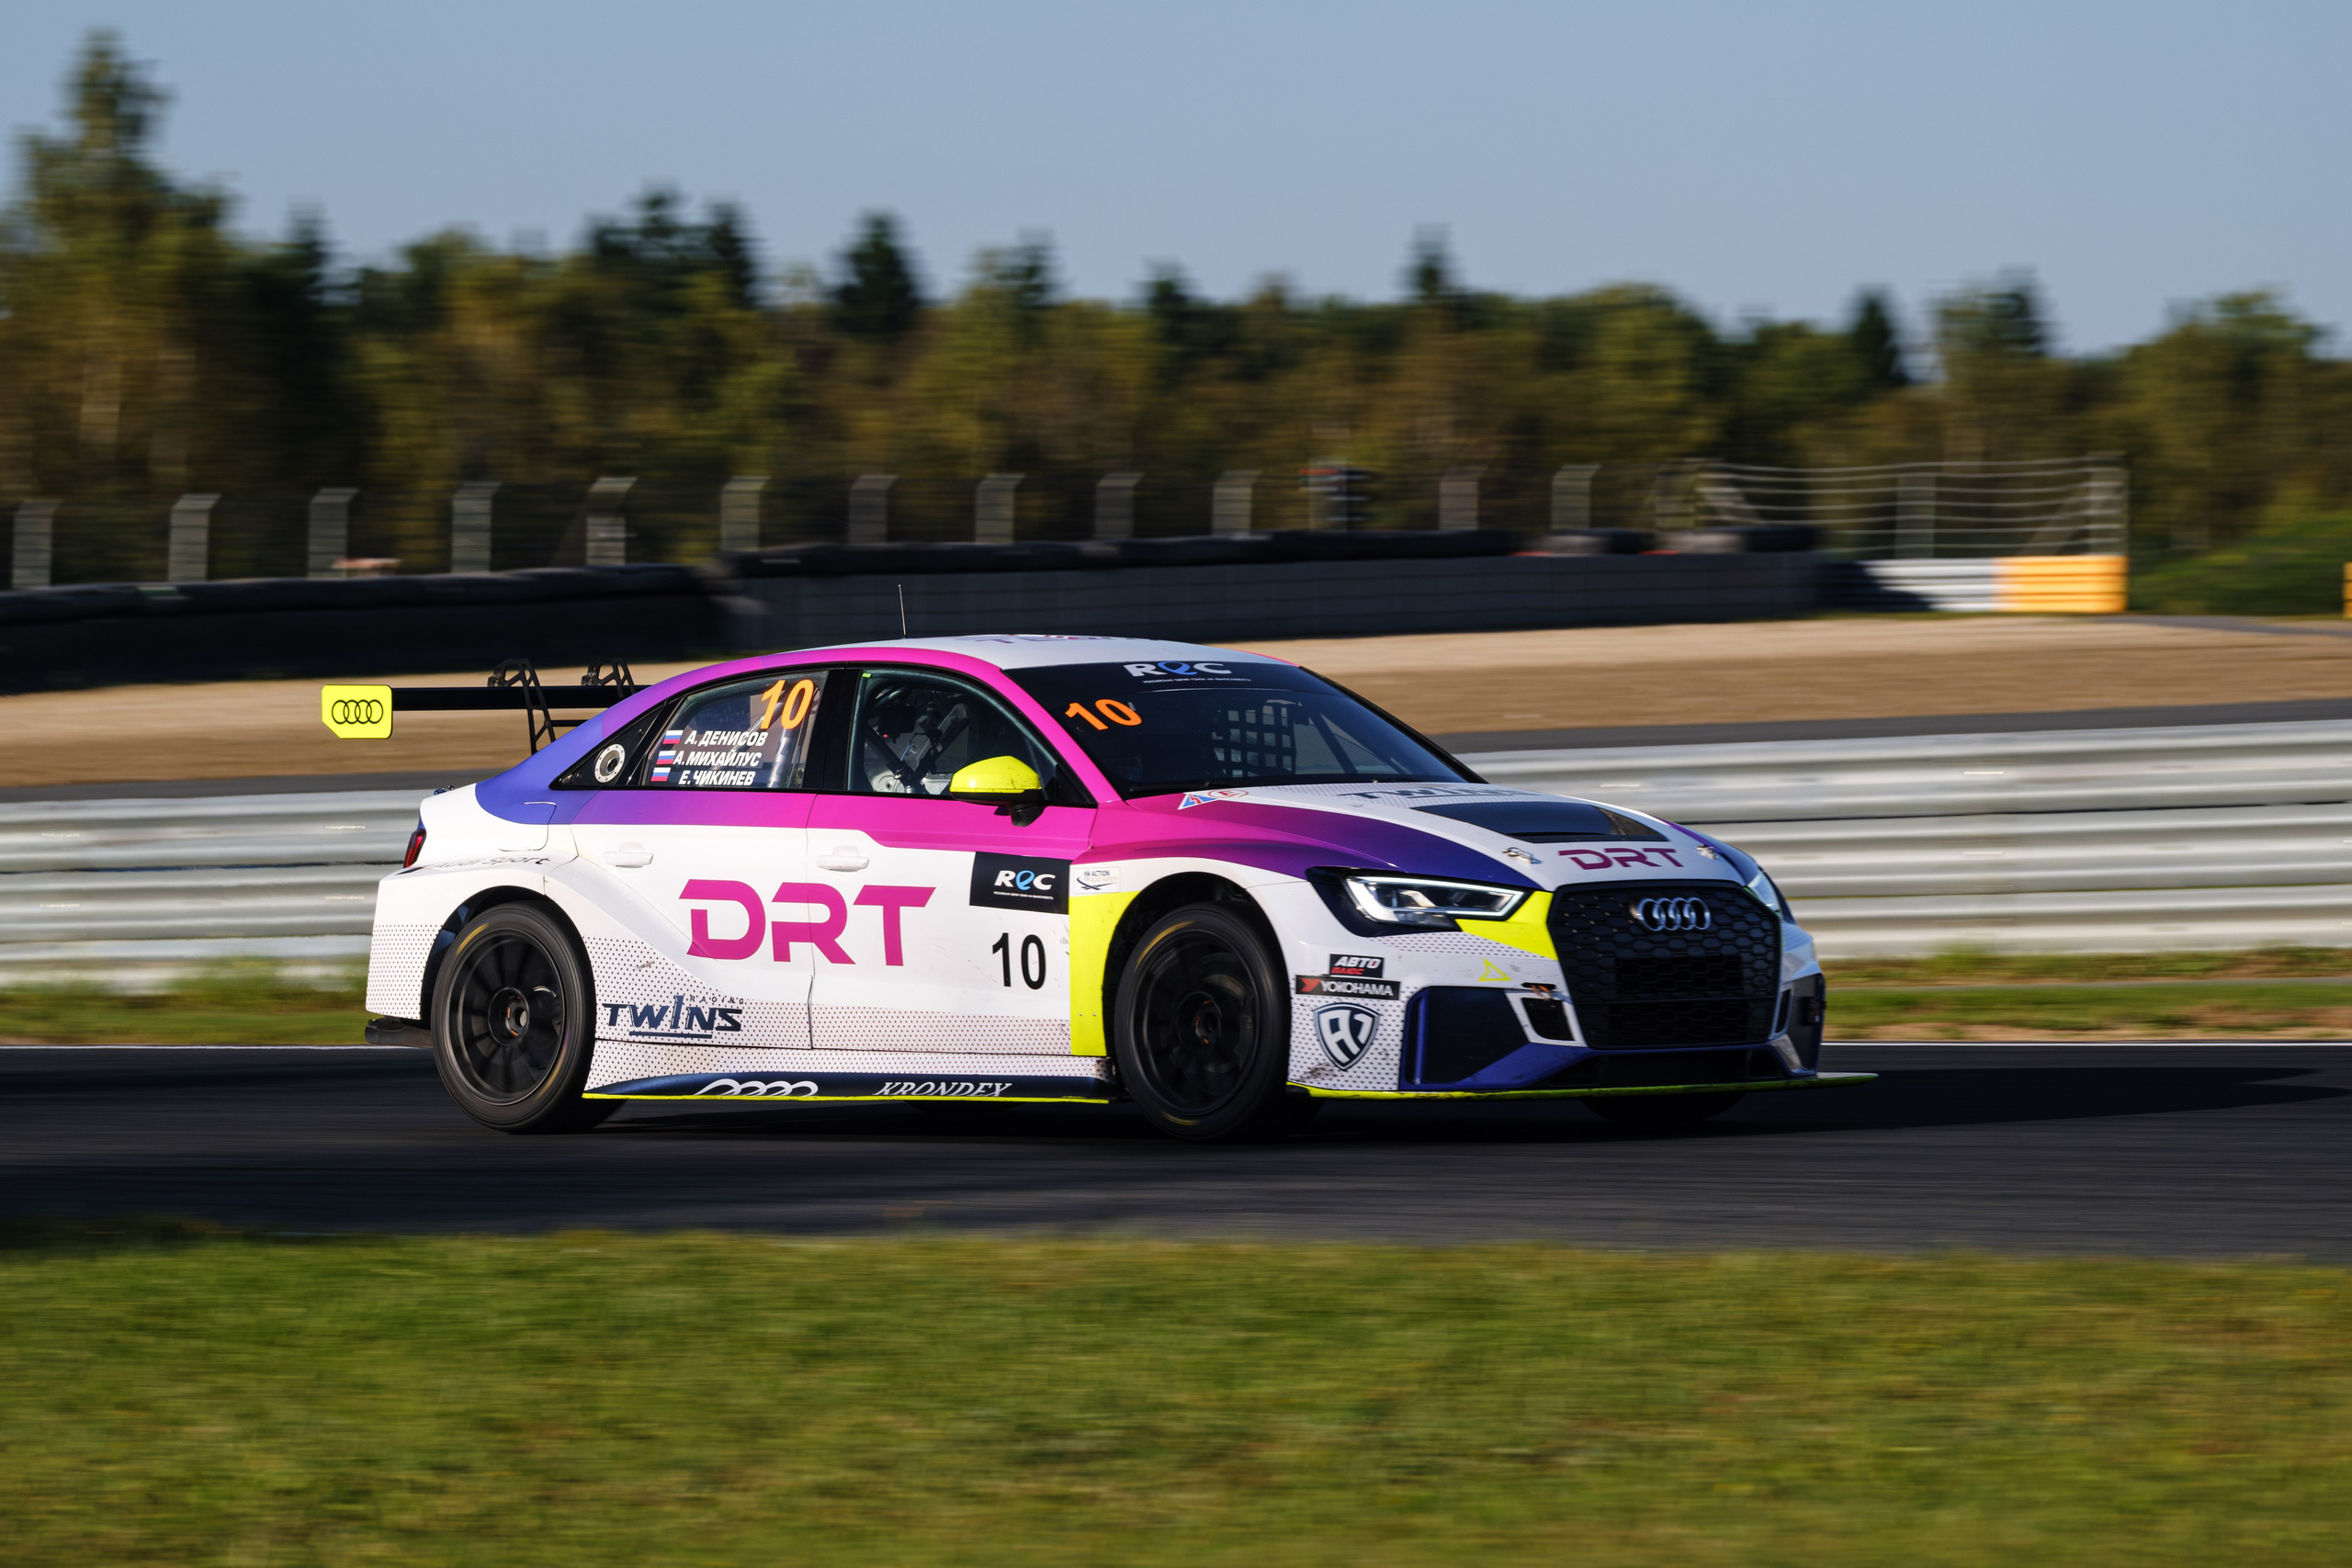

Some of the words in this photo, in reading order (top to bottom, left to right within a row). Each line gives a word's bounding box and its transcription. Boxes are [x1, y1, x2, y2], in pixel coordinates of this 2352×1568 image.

[760, 679, 815, 730] 10
[1065, 699, 1142, 730] 10
[1557, 847, 1684, 871] DRT
[678, 878, 936, 967] DRT
[991, 932, 1047, 990] 10
[1320, 980, 1394, 997] YOKOHAMA
[602, 995, 743, 1032] TWINS
[872, 1081, 1012, 1097] KRONDEX
